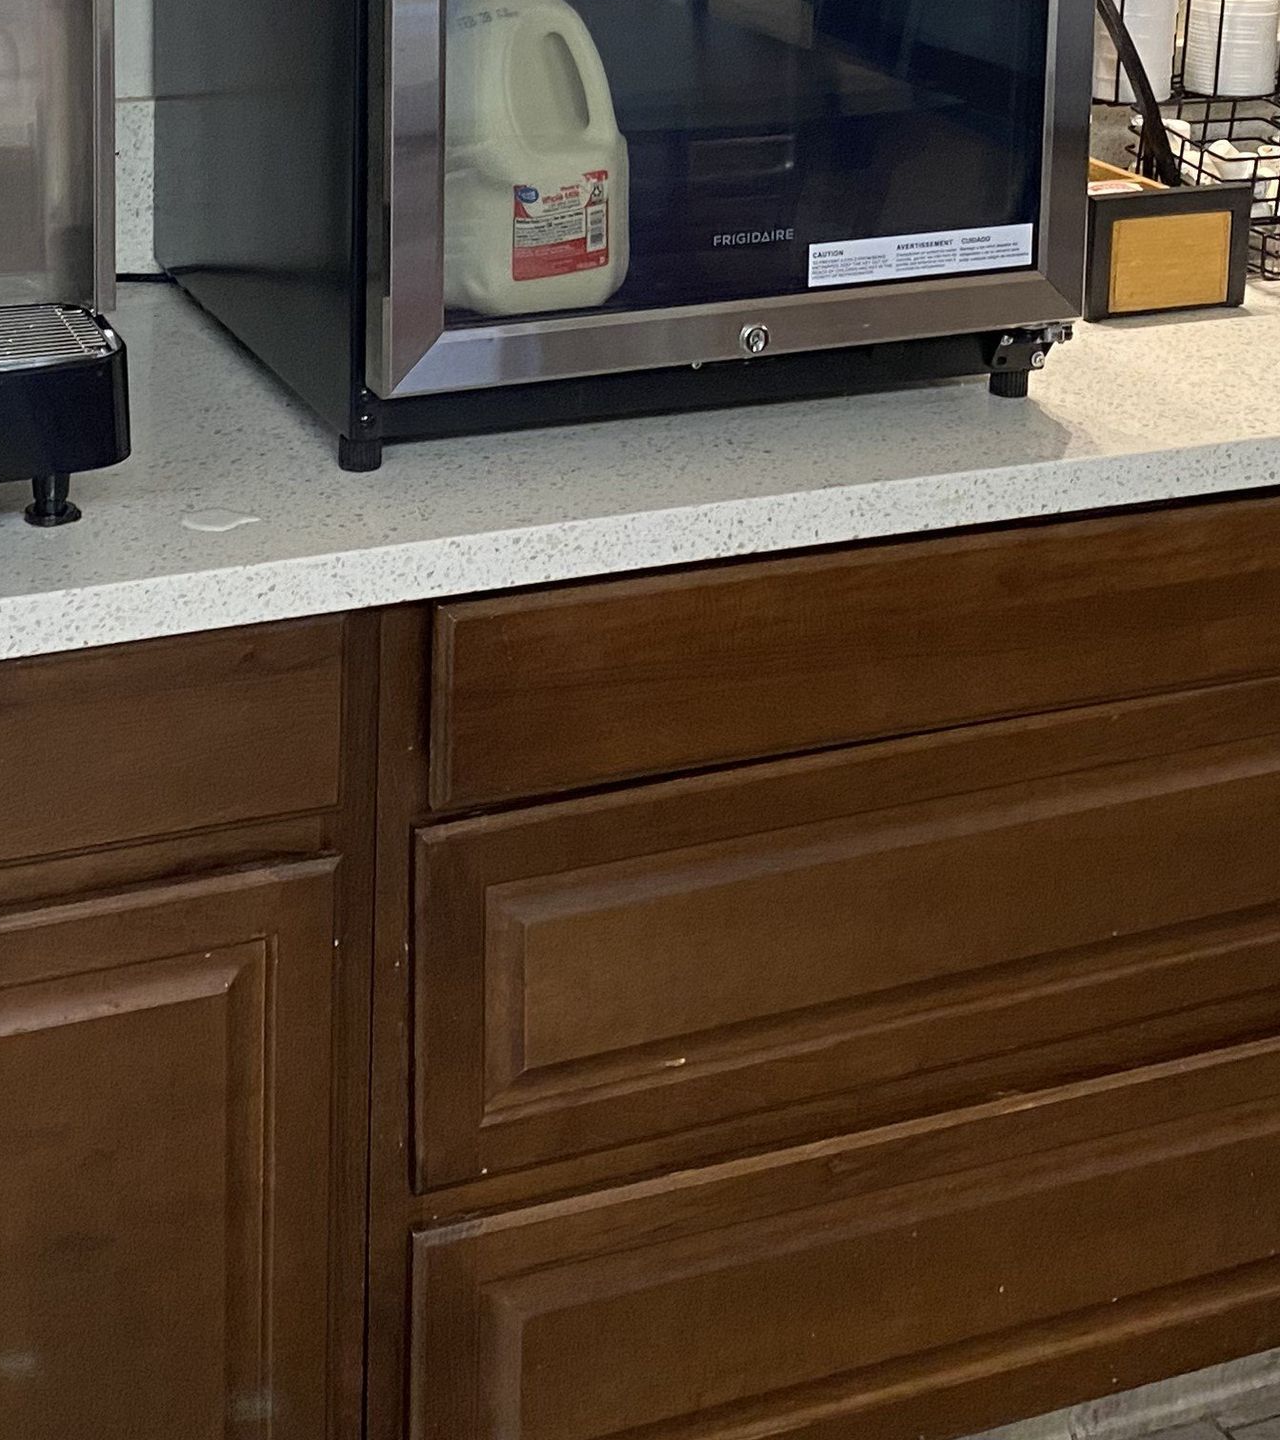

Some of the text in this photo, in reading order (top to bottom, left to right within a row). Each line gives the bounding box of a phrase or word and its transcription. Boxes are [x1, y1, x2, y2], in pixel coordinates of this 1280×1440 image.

[713, 228, 795, 247] FRIGIDAIRE
[895, 239, 954, 251] AVERTISSEMENT
[812, 250, 844, 259] CAUTION
